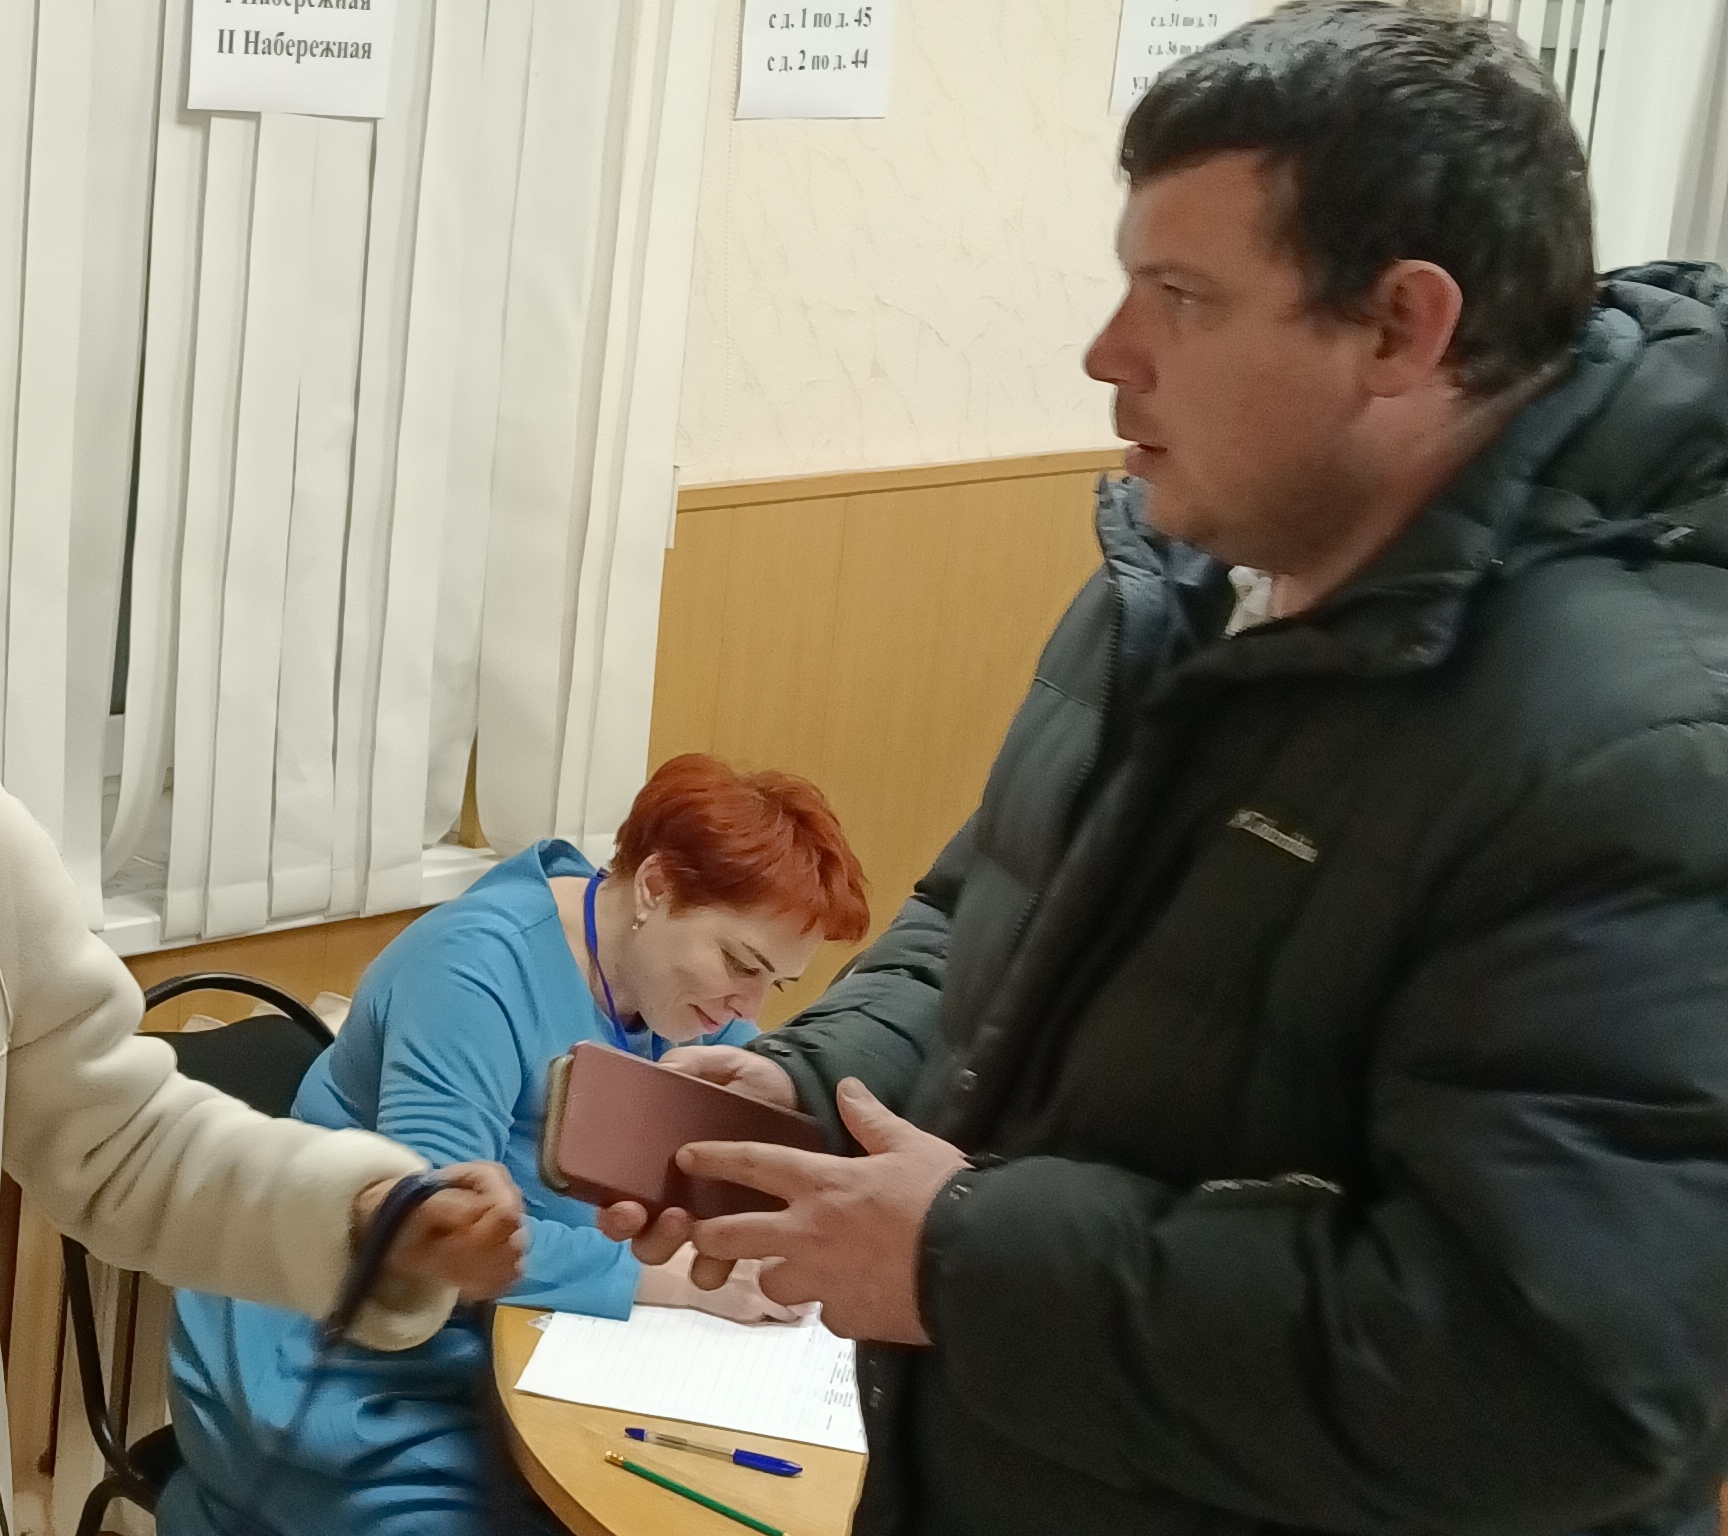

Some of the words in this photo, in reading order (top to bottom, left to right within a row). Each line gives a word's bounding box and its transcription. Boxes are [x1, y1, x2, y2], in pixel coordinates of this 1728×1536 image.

[768, 13, 777, 28] с
[780, 13, 794, 30] д.
[801, 7, 807, 28] 1
[813, 12, 832, 28] по
[835, 12, 849, 29] д.
[853, 6, 872, 27] 45
[217, 29, 236, 54] II
[243, 30, 372, 64] Набережная
[767, 55, 775, 72] с
[779, 55, 793, 73] д.
[798, 49, 806, 70] 2
[812, 54, 830, 70] по
[833, 54, 846, 71] д.
[851, 48, 869, 69] 44
